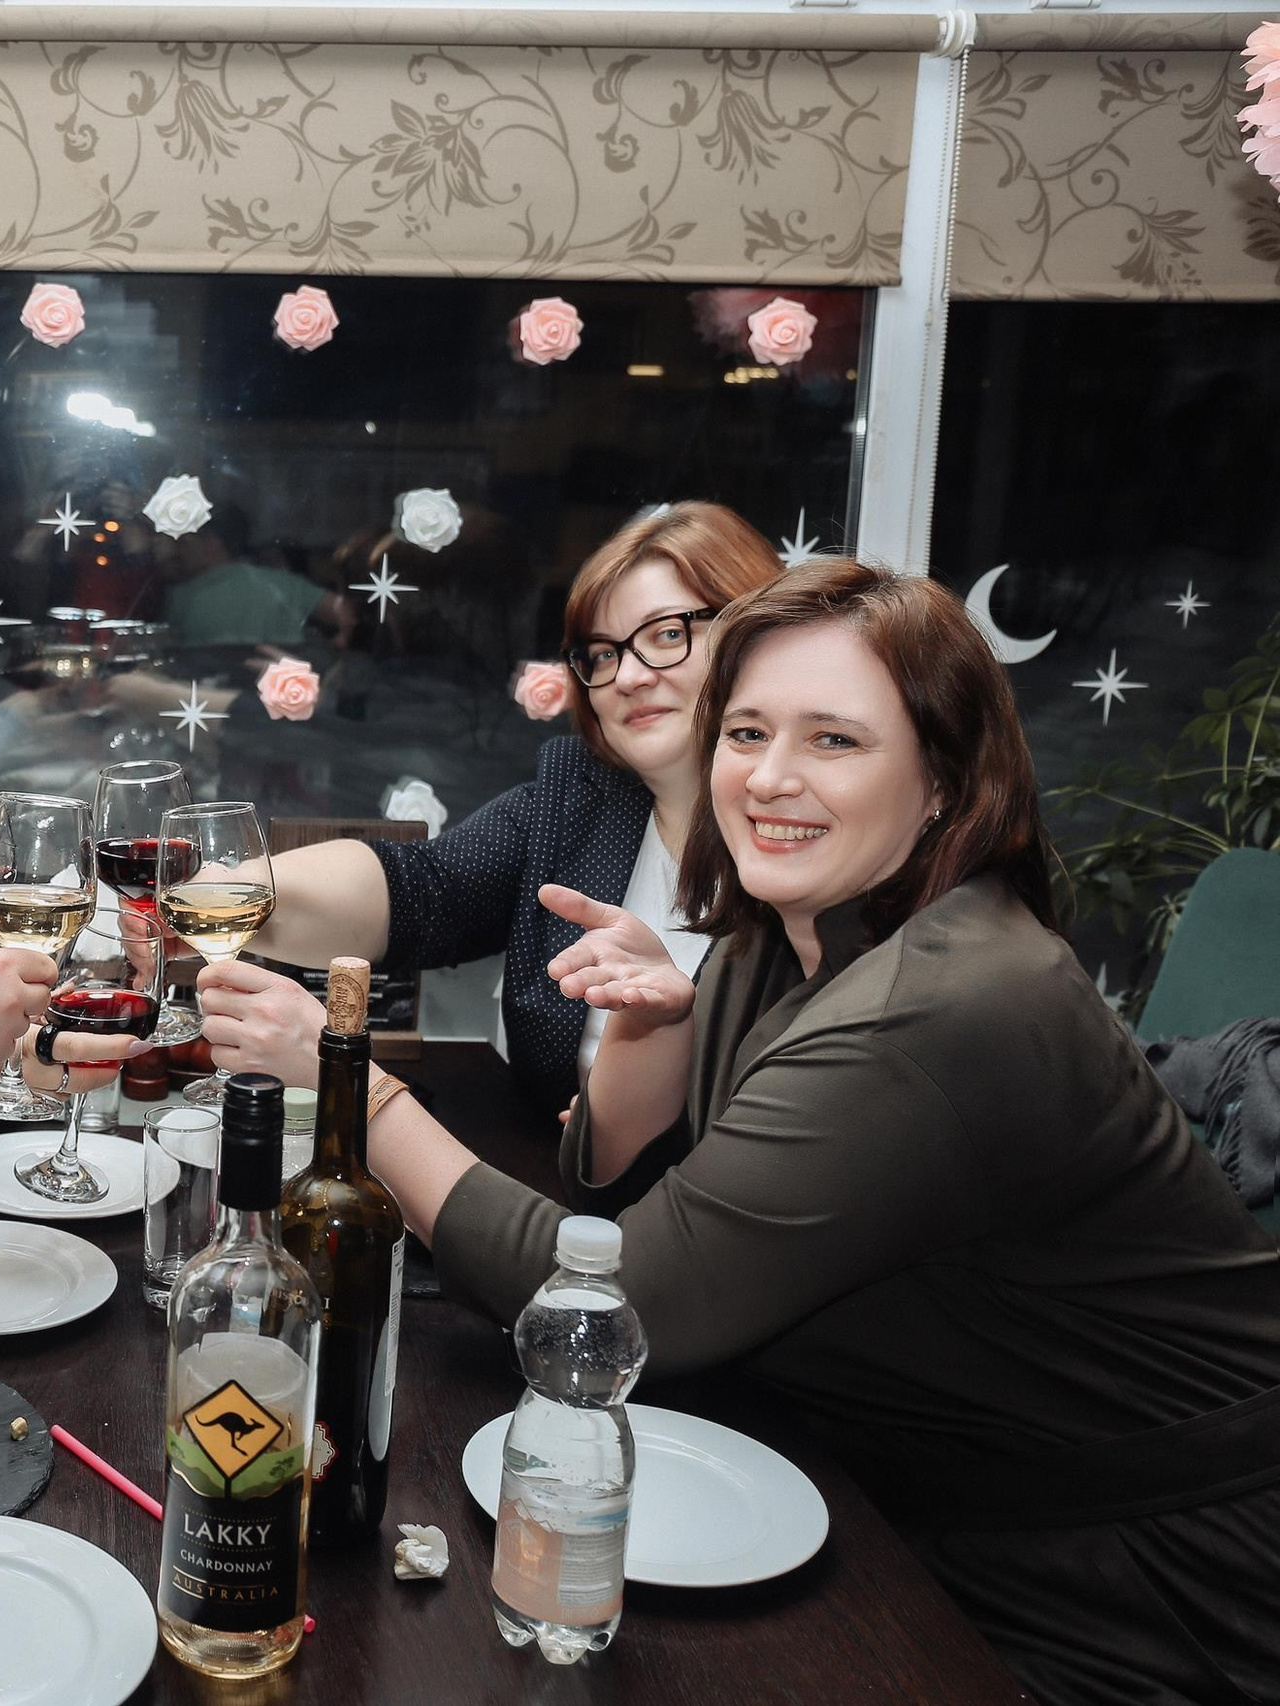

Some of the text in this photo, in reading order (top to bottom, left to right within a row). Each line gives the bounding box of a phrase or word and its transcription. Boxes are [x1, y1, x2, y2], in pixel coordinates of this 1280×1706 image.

[184, 1513, 271, 1546] LAKKY
[180, 1549, 273, 1573] CHARDONNAY
[173, 1573, 279, 1600] AUSTRALIA
